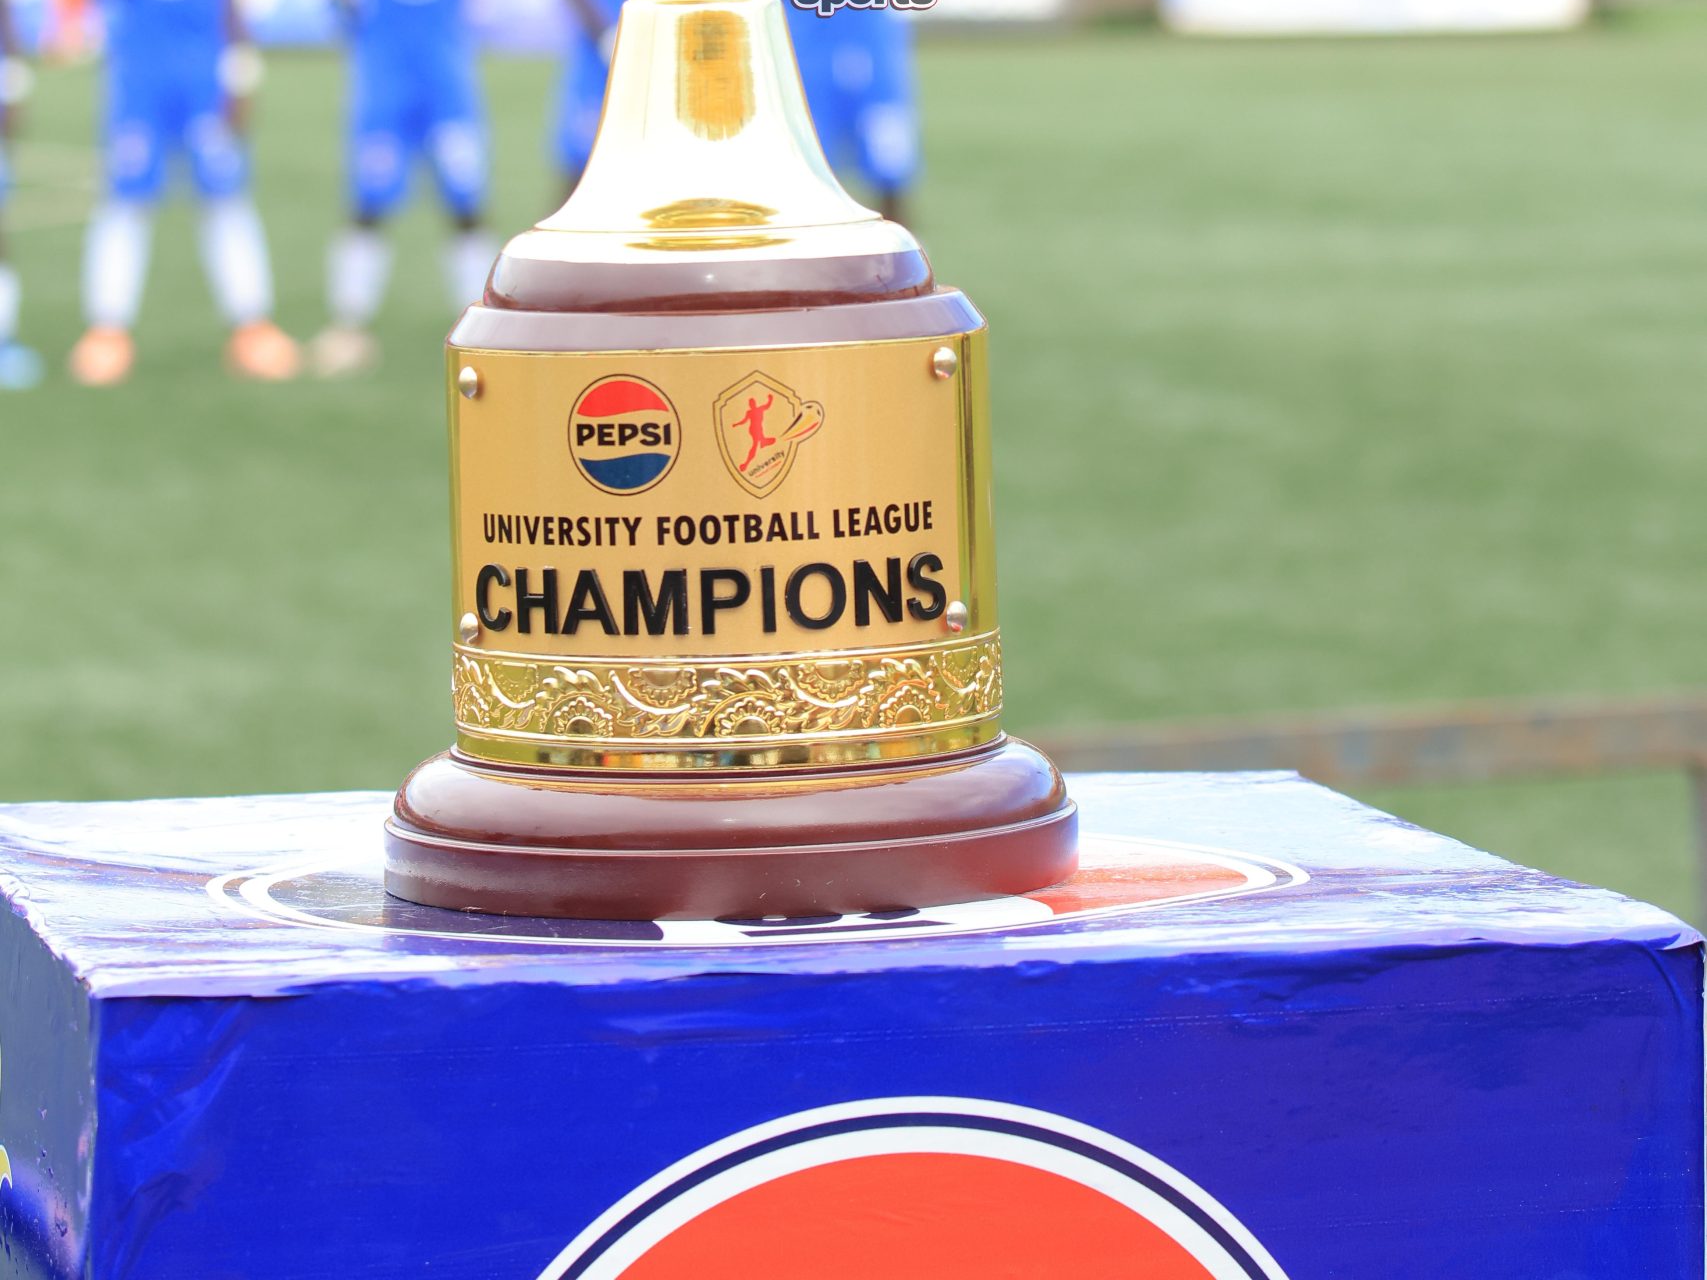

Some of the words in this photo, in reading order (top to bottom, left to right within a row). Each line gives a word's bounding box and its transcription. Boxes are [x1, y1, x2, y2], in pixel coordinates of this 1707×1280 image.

[576, 422, 671, 446] PEPSI
[483, 513, 643, 547] UNIVERSITY
[656, 510, 820, 546] FOOTBALL
[833, 500, 933, 539] LEAGUE
[475, 551, 947, 636] CHAMPIONS
